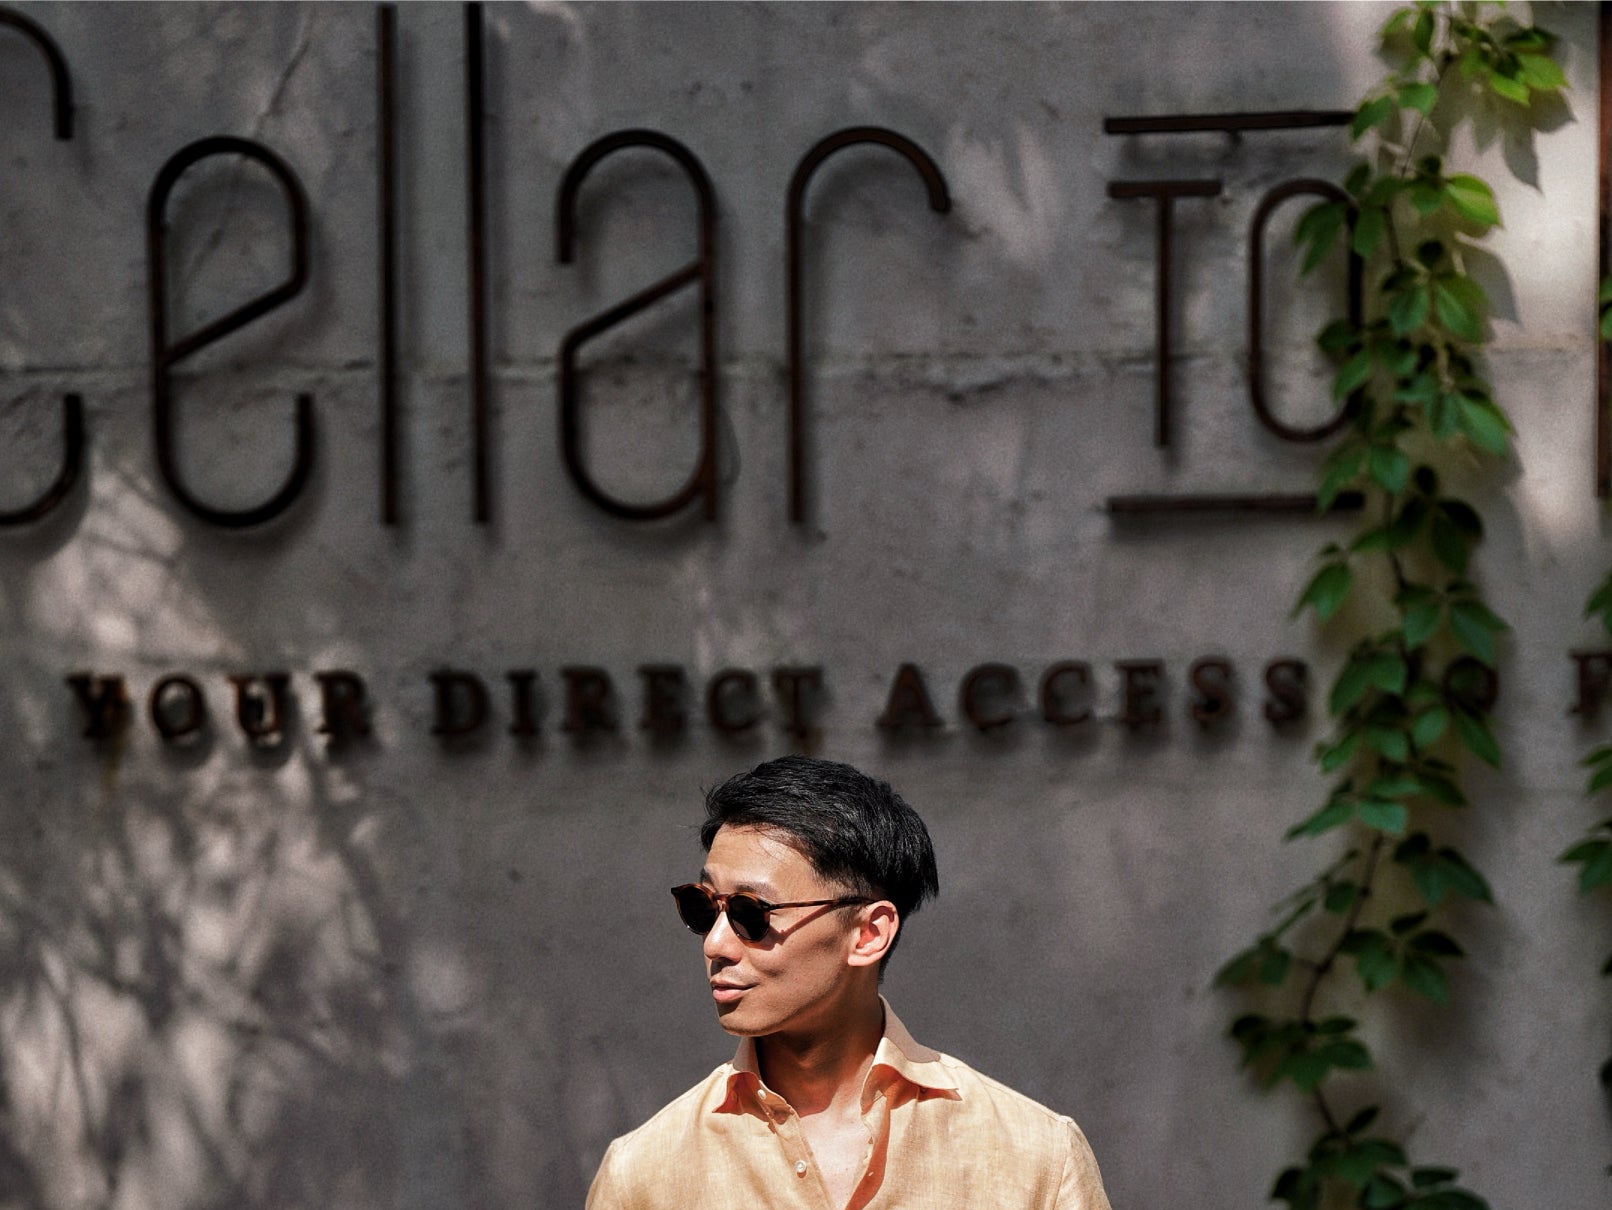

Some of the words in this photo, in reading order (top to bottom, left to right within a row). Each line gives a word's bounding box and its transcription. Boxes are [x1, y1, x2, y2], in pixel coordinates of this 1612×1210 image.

[1107, 177, 1365, 450] TO
[64, 668, 371, 739] YOUR
[427, 663, 825, 737] DIRECT
[876, 657, 1311, 731] ACCESS
